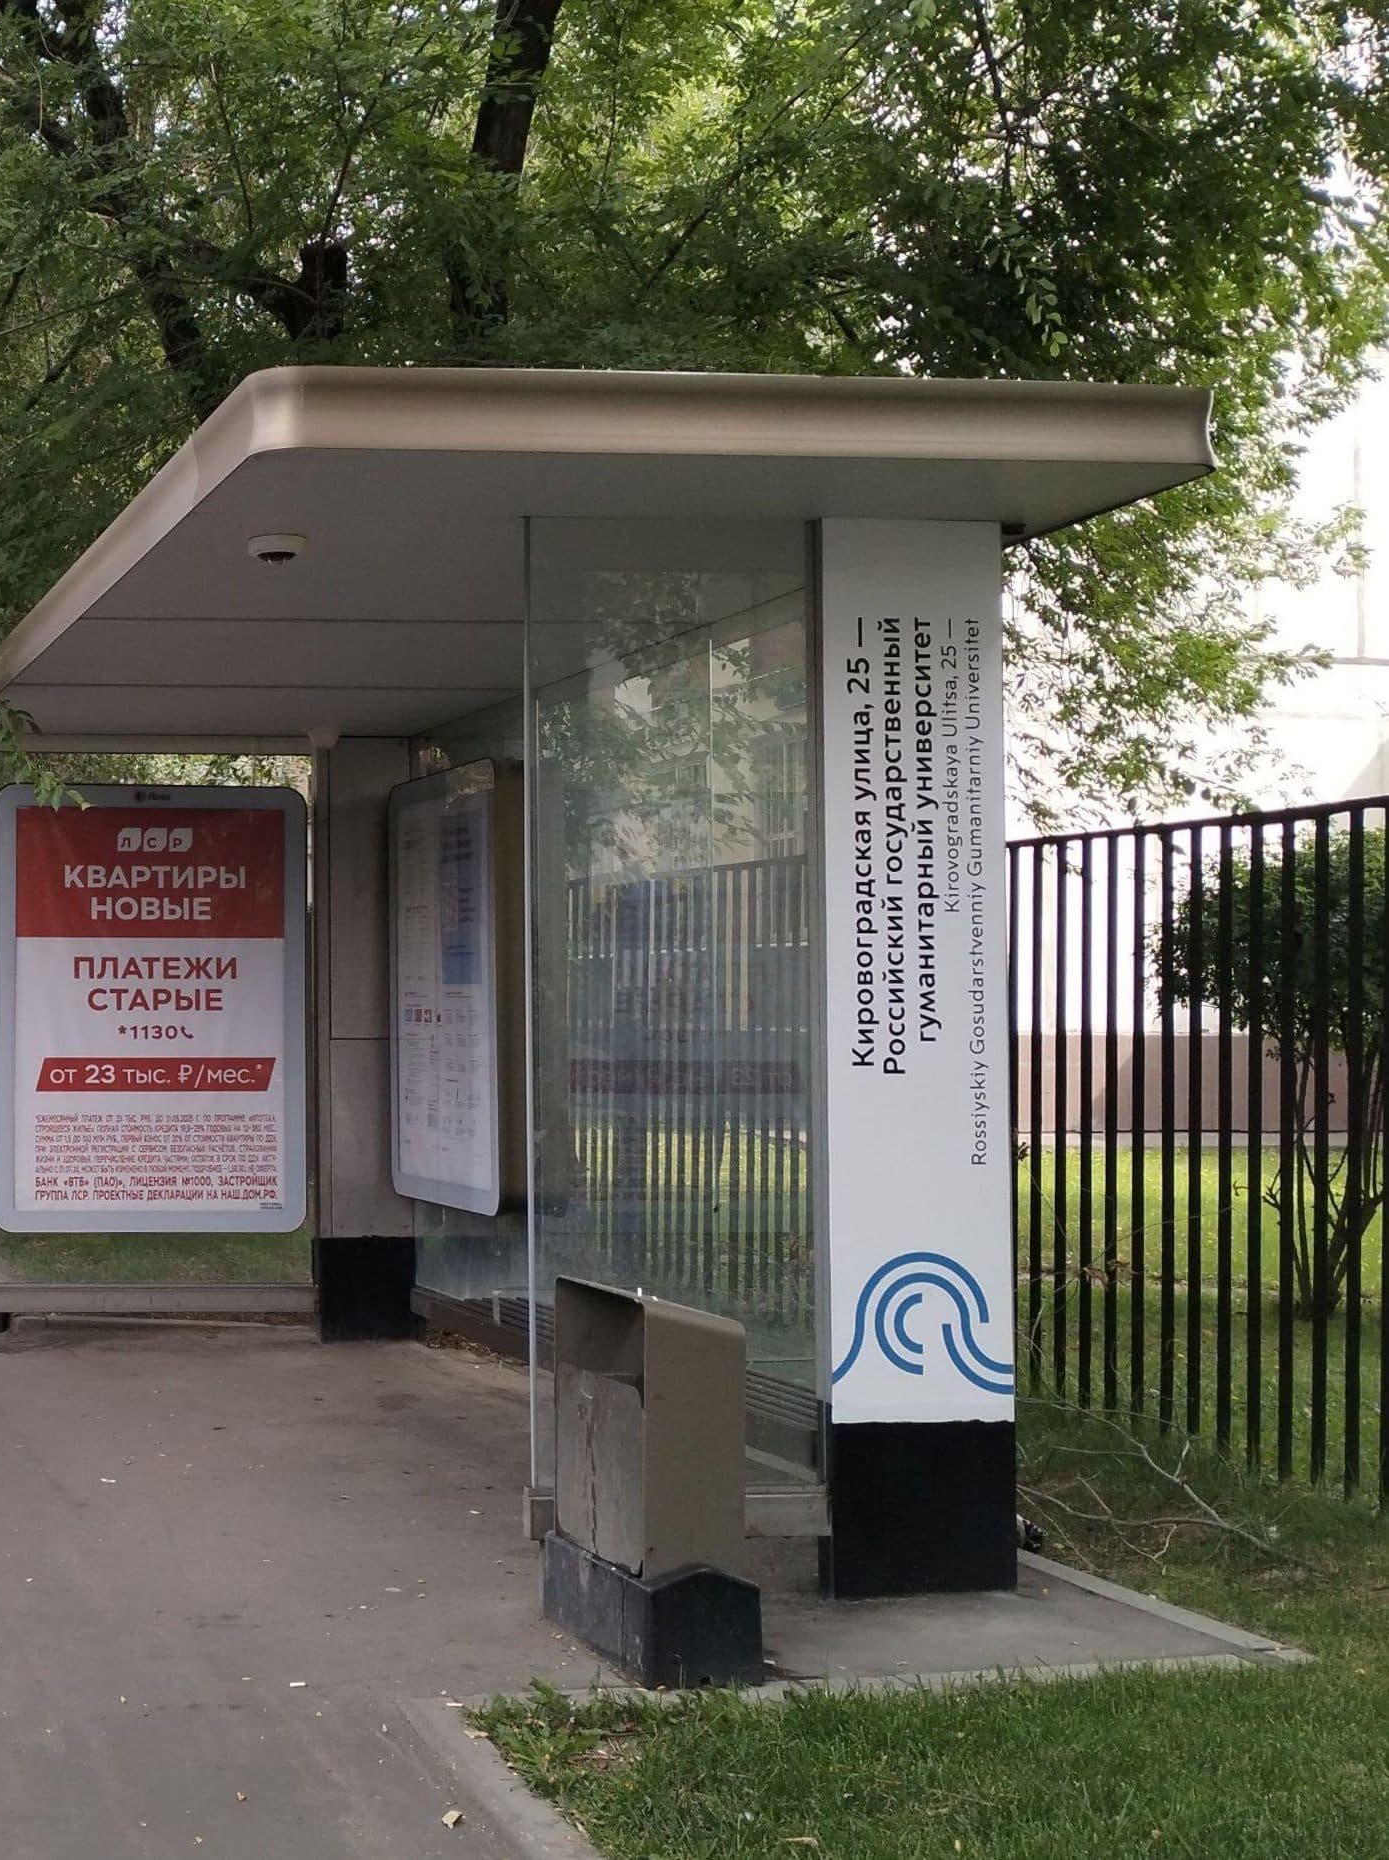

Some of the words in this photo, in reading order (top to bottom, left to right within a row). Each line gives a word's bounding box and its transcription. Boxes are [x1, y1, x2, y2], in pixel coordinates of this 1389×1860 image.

[847, 658, 870, 694] 25
[941, 645, 957, 669] 25
[964, 618, 980, 730] Universitet
[854, 704, 877, 801] улица,
[877, 618, 908, 884] государственный
[914, 617, 939, 810] университет
[941, 676, 959, 737] Ulitsa,
[942, 745, 963, 912] Kirovogradskaya
[965, 736, 984, 876] Gumanitarniy
[63, 864, 246, 889] КВАРТИРЫ
[90, 896, 212, 920] НОВЫЕ
[73, 956, 238, 980] ПЛАТЕЖИ
[852, 811, 880, 1066] Кировоградская
[911, 820, 942, 1041] гуманитарный
[967, 882, 987, 1054] Gosudarstvenniy
[87, 987, 223, 1011] СТАРЫЕ
[881, 896, 906, 1074] Российский
[49, 1068, 77, 1084] от
[84, 1064, 116, 1085] 23
[122, 1068, 171, 1084] тыс.
[970, 1060, 990, 1165] Rossiyskiy
[35, 1176, 59, 1187] БАНК
[130, 1176, 177, 1187] ЛИЦЕНЗИЯ
[218, 1174, 277, 1187] ЗАСТРОЙЩИК
[35, 1190, 69, 1200] ГРУППА
[93, 1190, 144, 1200] ПРОЕКТНЫЕ
[147, 1190, 204, 1200] ДЕКЛАРАЦИИ
[207, 1190, 218, 1200] НА
